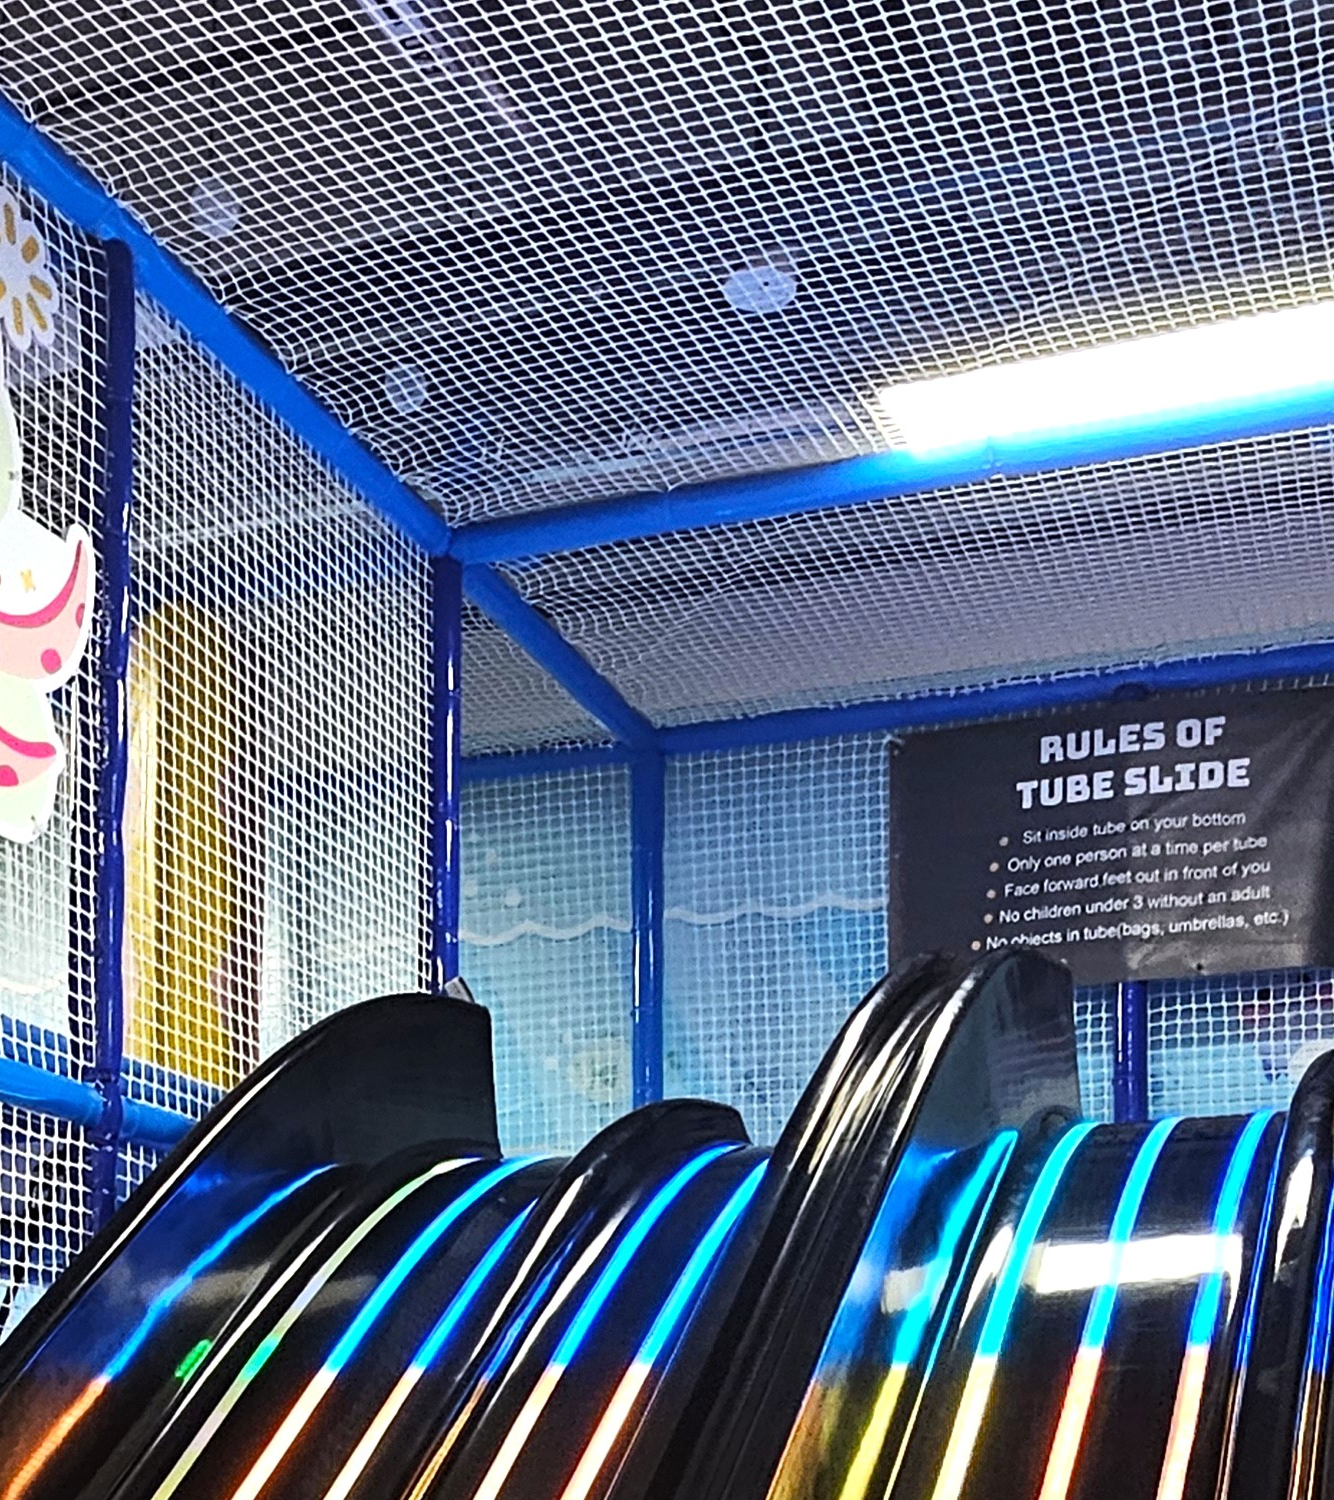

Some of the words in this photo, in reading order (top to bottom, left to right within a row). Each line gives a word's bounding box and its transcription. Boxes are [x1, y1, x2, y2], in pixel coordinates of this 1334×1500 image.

[1040, 721, 1166, 764] RULES
[1176, 715, 1226, 749] OF
[1016, 770, 1115, 809] TUBE
[1124, 757, 1251, 796] SLIDE
[1022, 830, 1042, 844] Sit
[1045, 825, 1088, 841] inside
[1093, 821, 1126, 836] tube
[1130, 818, 1149, 831] on
[1153, 816, 1188, 833] your
[1192, 812, 1246, 827] bottom
[1007, 856, 1041, 872] Only
[1044, 854, 1071, 867] one
[1075, 847, 1127, 866] person
[1131, 843, 1147, 857] at
[1150, 844, 1161, 856] a
[1165, 841, 1198, 855] time
[1203, 840, 1230, 857] per
[1233, 836, 1268, 851] tube
[1004, 883, 1040, 898] Face
[1135, 869, 1160, 883] out
[1164, 867, 1178, 882] in
[1182, 865, 1218, 880] front
[1222, 862, 1238, 877] of
[1241, 860, 1271, 878] you
[999, 909, 1020, 924] No
[1023, 904, 1081, 921] children
[1085, 897, 1129, 914] under
[1132, 895, 1143, 910] 3
[1147, 892, 1203, 909] without
[1207, 891, 1226, 904] an
[1231, 885, 1271, 902] adult
[1066, 928, 1080, 942] in
[1169, 914, 1249, 933] umbrellas,
[1254, 908, 1289, 926] etc.)
